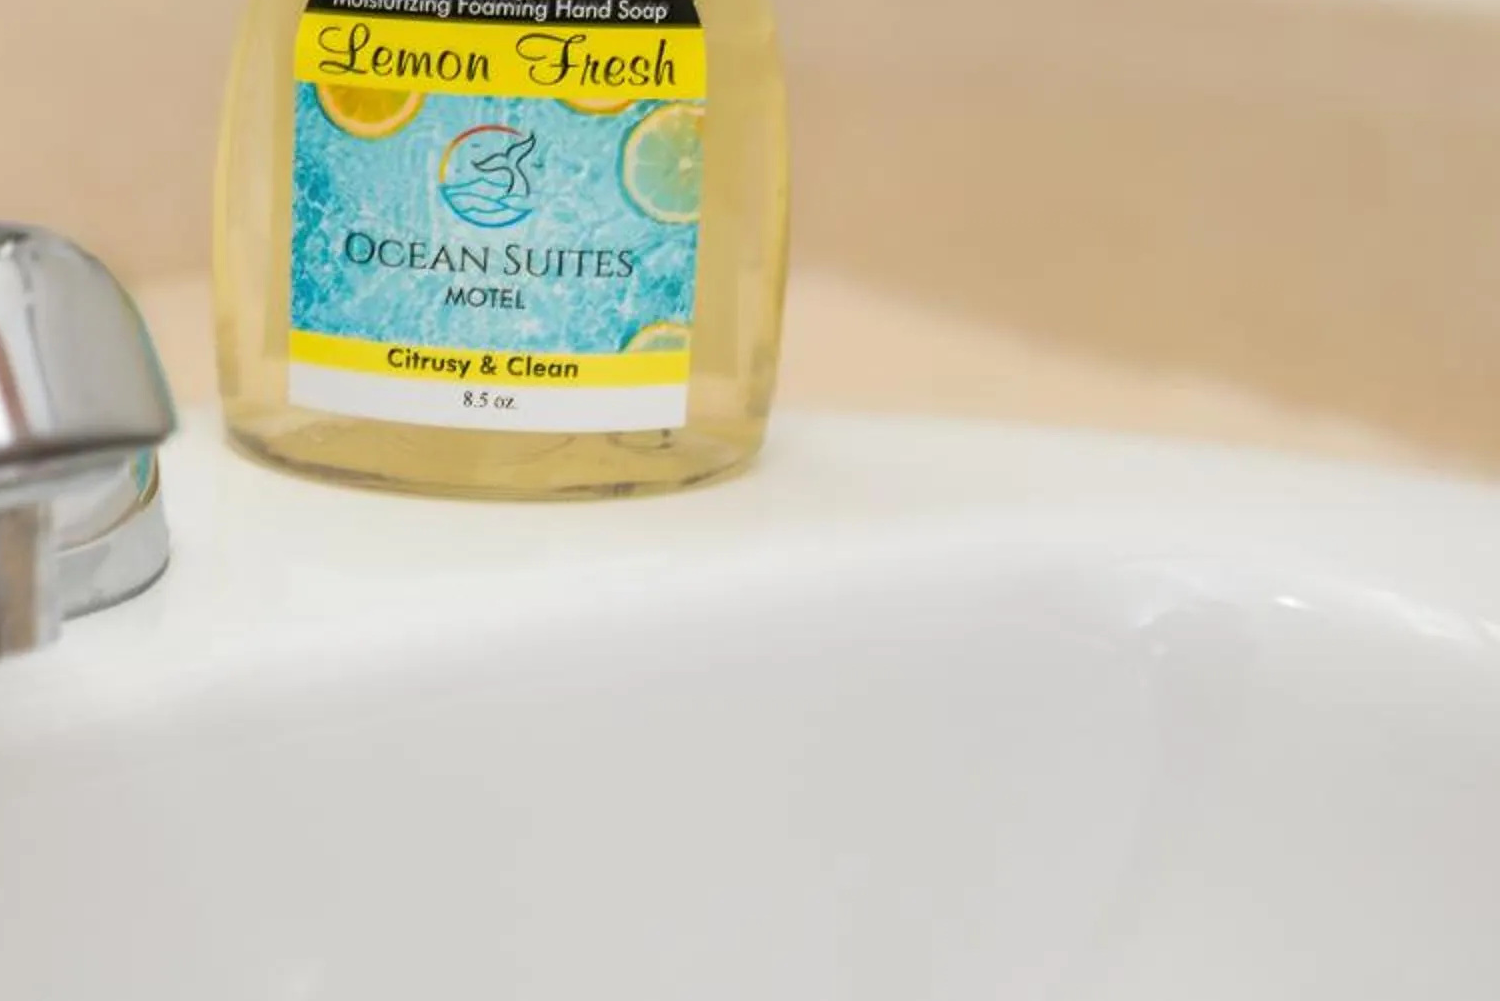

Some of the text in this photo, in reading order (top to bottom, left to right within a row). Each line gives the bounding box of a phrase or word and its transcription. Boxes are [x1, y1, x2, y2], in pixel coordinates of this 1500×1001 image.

[618, 0, 667, 24] Soap
[318, 22, 675, 87] Lemon Fresh
[345, 231, 635, 278] OCEAN SUITES
[445, 286, 525, 310] MOTEL
[387, 348, 579, 378] Citrusy & Clean
[463, 390, 488, 408] 8.5
